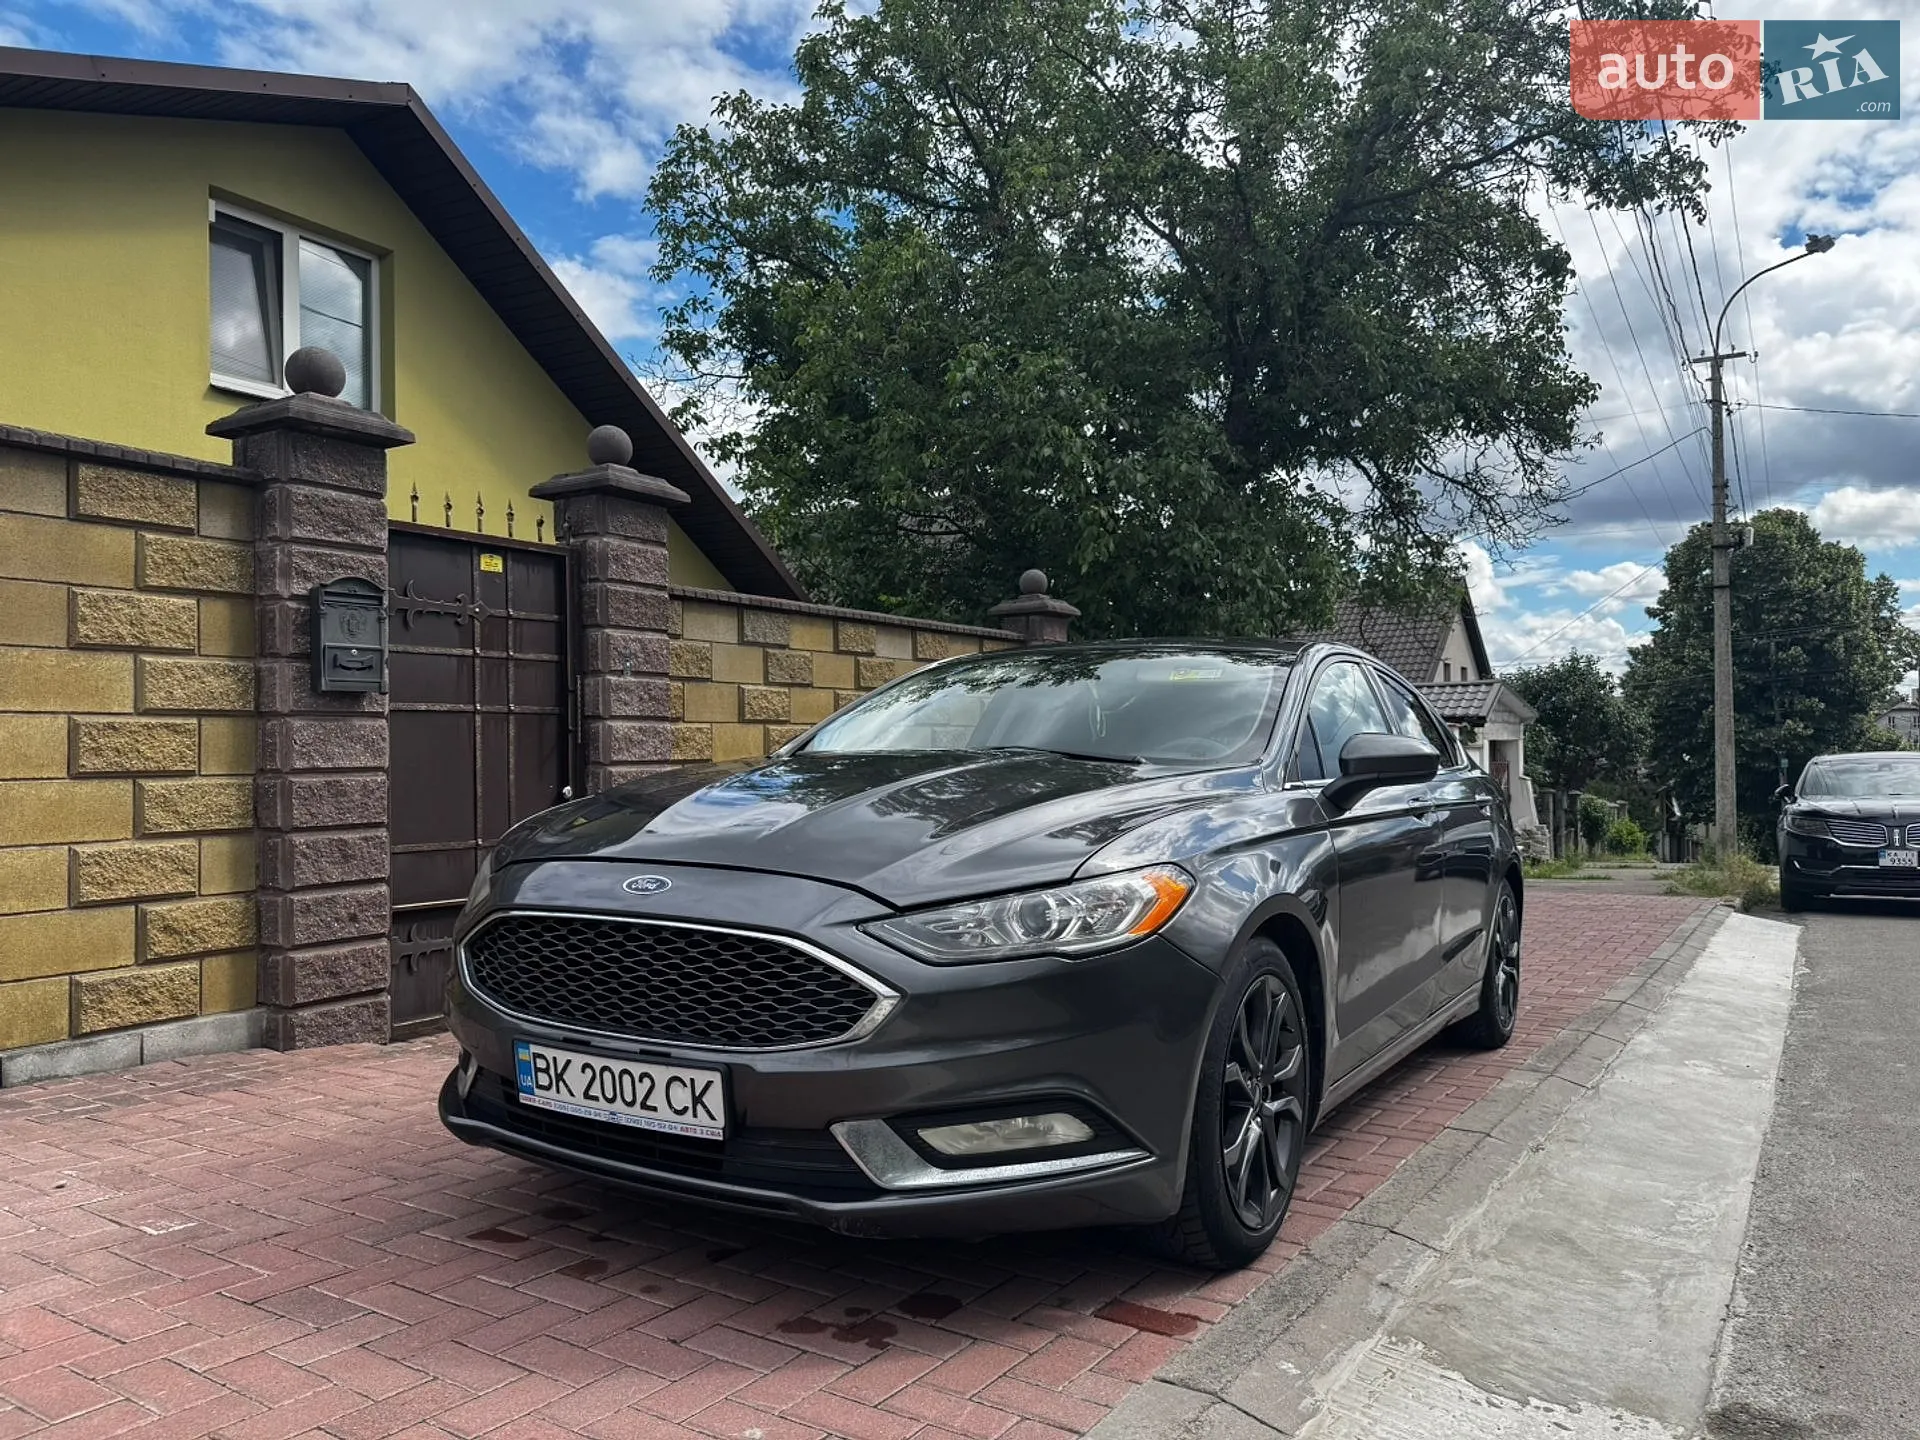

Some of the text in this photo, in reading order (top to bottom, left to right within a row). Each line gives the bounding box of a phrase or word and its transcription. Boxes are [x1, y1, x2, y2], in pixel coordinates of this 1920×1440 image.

[631, 878, 661, 890] Ford
[520, 1074, 533, 1087] UA
[532, 1052, 717, 1121] BK 2002 CK
